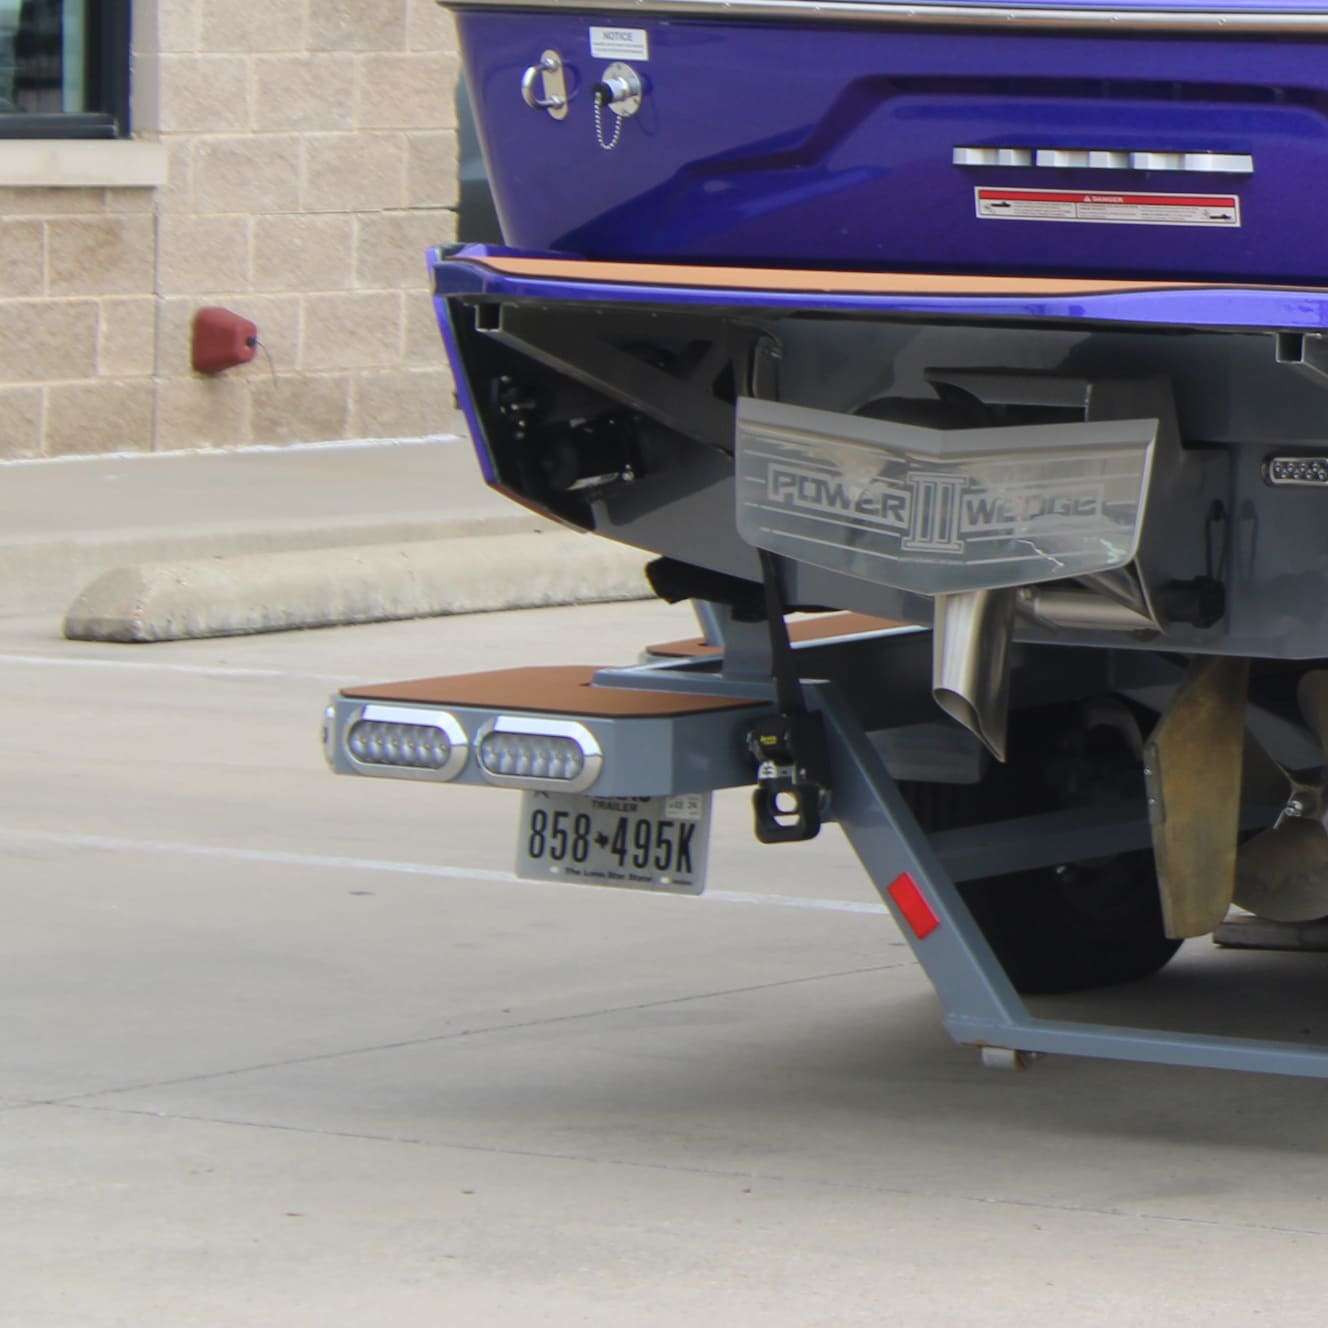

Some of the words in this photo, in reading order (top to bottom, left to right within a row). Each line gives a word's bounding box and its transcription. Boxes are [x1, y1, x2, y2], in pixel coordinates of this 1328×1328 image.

[602, 31, 633, 42] NOTICE
[1092, 195, 1124, 204] DANGER
[773, 469, 906, 524] POWER
[592, 799, 639, 813] TRAILER
[529, 809, 591, 863] 858
[611, 816, 695, 874] 495K
